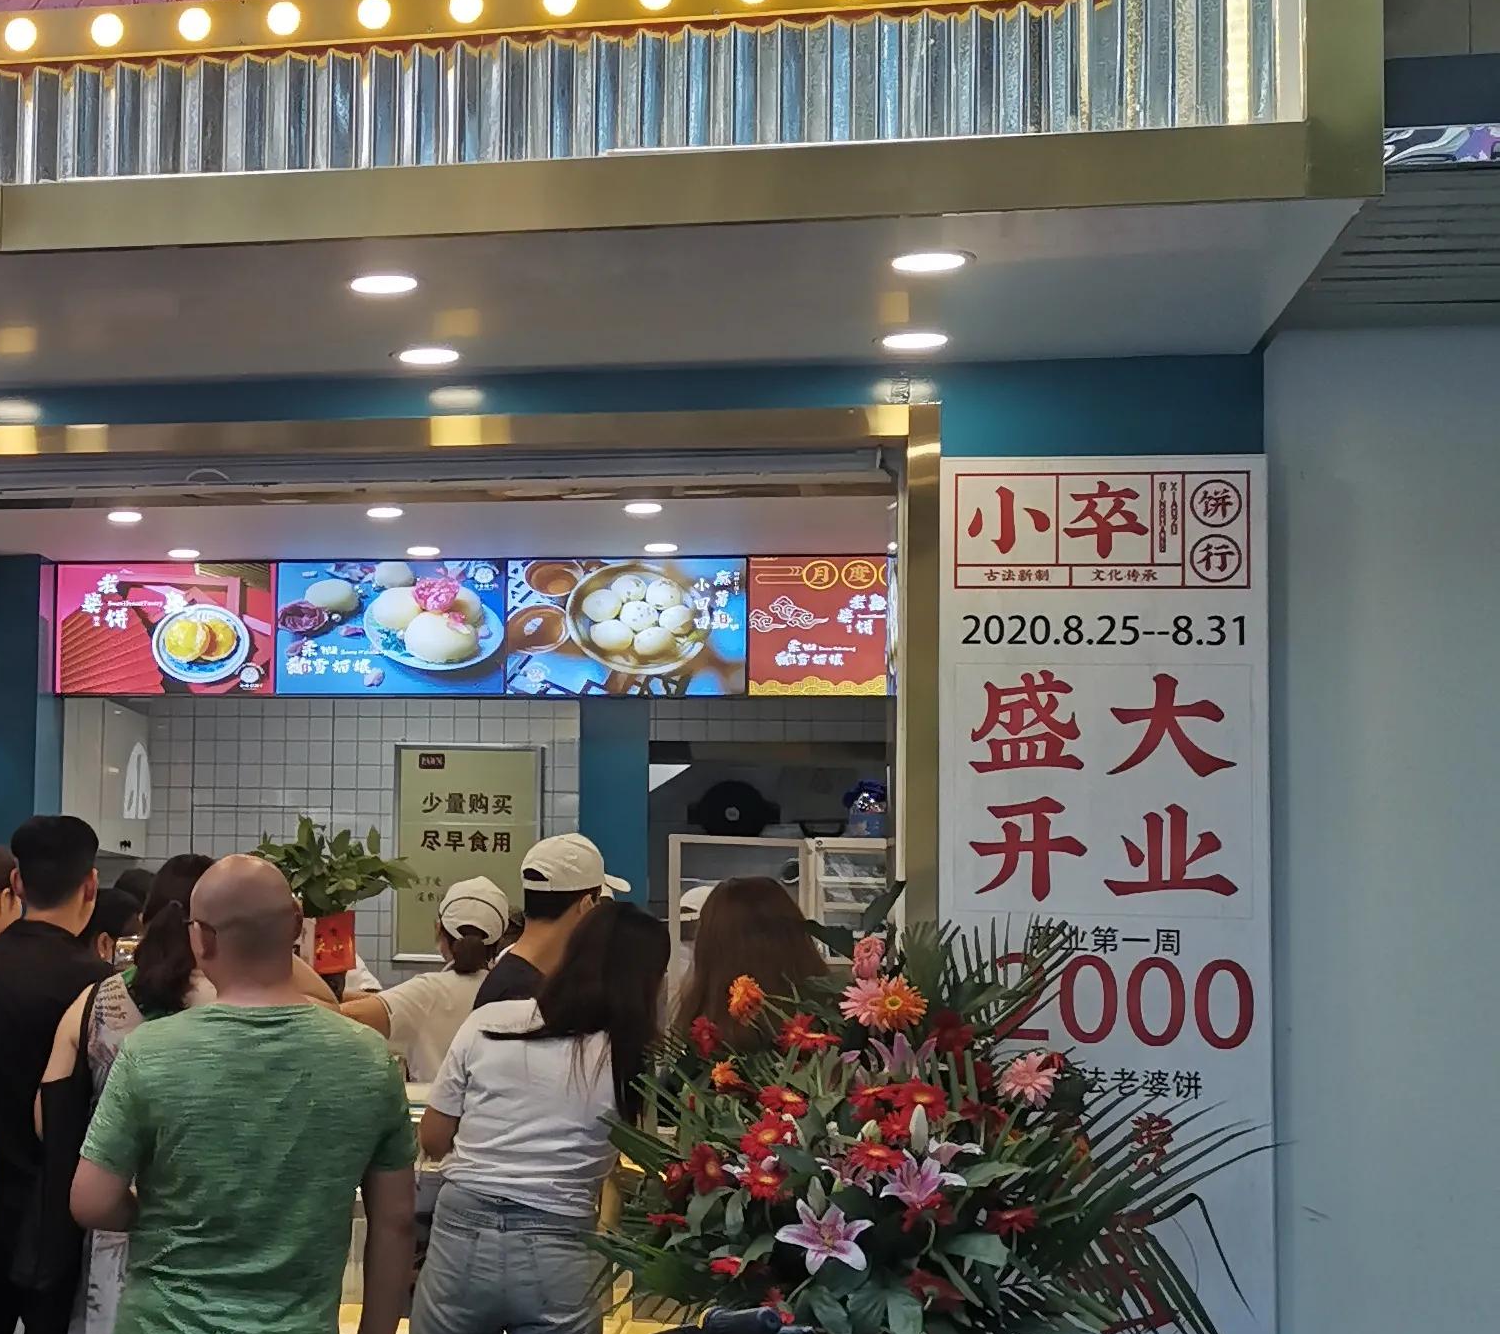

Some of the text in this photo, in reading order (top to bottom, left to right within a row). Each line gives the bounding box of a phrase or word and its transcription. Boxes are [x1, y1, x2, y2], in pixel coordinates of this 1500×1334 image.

[967, 481, 1149, 558] 小卒
[1197, 488, 1235, 572] 饼行
[1091, 568, 1159, 583] 文化传承
[968, 669, 1237, 778] 盛大
[421, 792, 512, 815] 少量购买
[421, 830, 512, 853] 尽早食用
[968, 796, 1238, 901] 开业
